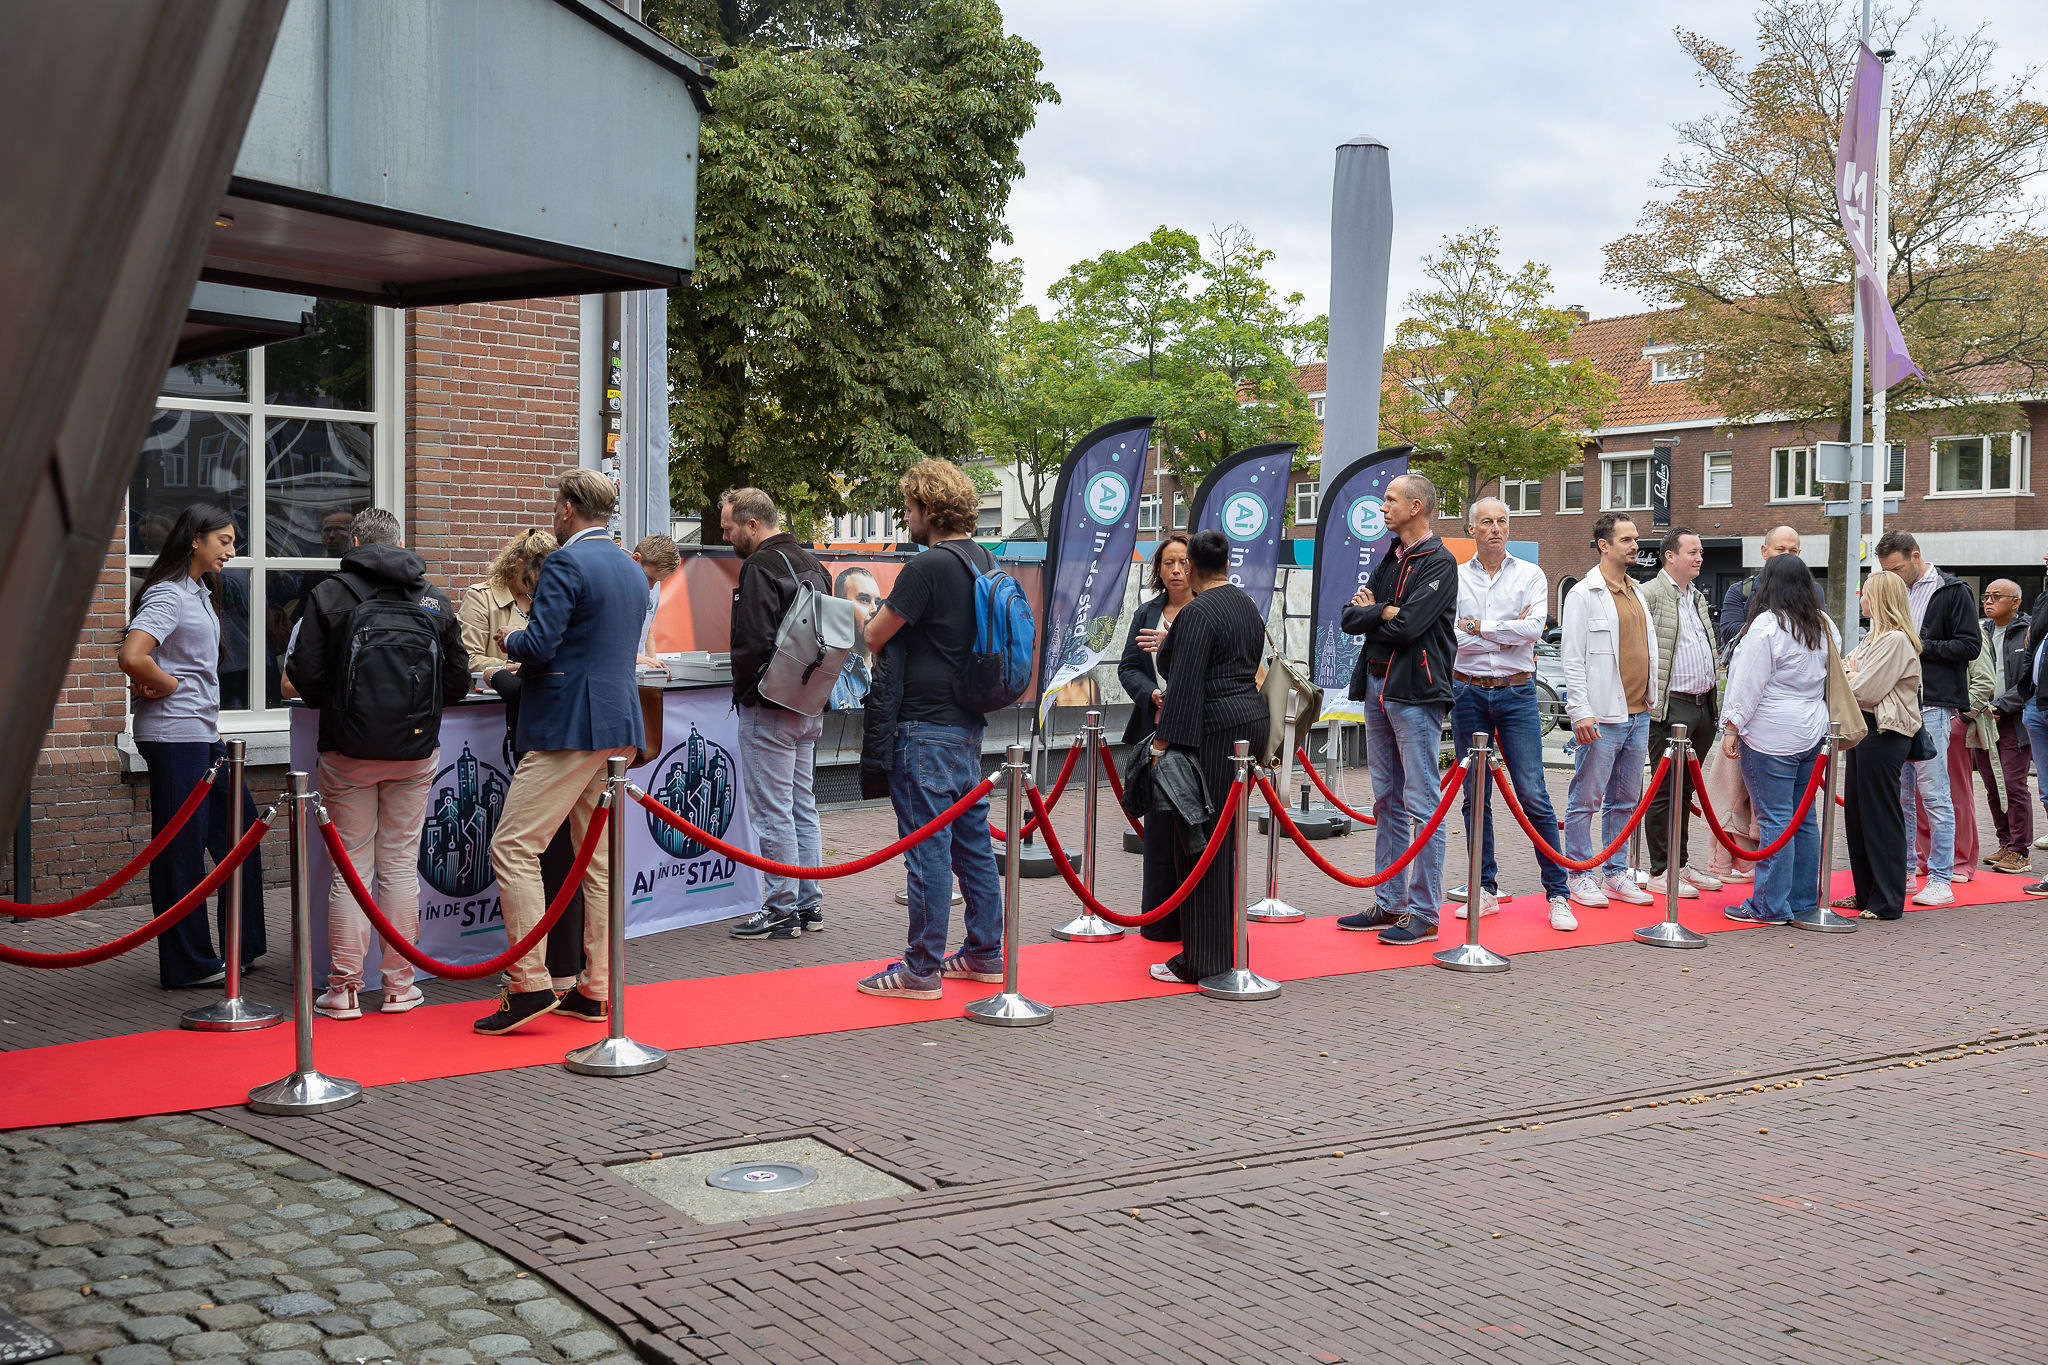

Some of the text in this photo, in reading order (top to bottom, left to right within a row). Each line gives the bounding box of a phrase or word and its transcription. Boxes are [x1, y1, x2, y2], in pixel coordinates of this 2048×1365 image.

[1099, 483, 1117, 512] Ai
[1654, 463, 1670, 508] Luxaflex
[1235, 503, 1254, 529] Ai
[1361, 506, 1378, 529] Ai
[1094, 531, 1110, 553] in
[1230, 547, 1249, 567] in
[1359, 547, 1375, 566] in
[1074, 594, 1092, 637] stad
[632, 870, 655, 896] AI
[671, 863, 686, 877] DE
[686, 858, 736, 886] STAD
[444, 902, 460, 917] DE
[461, 896, 504, 927] STA
